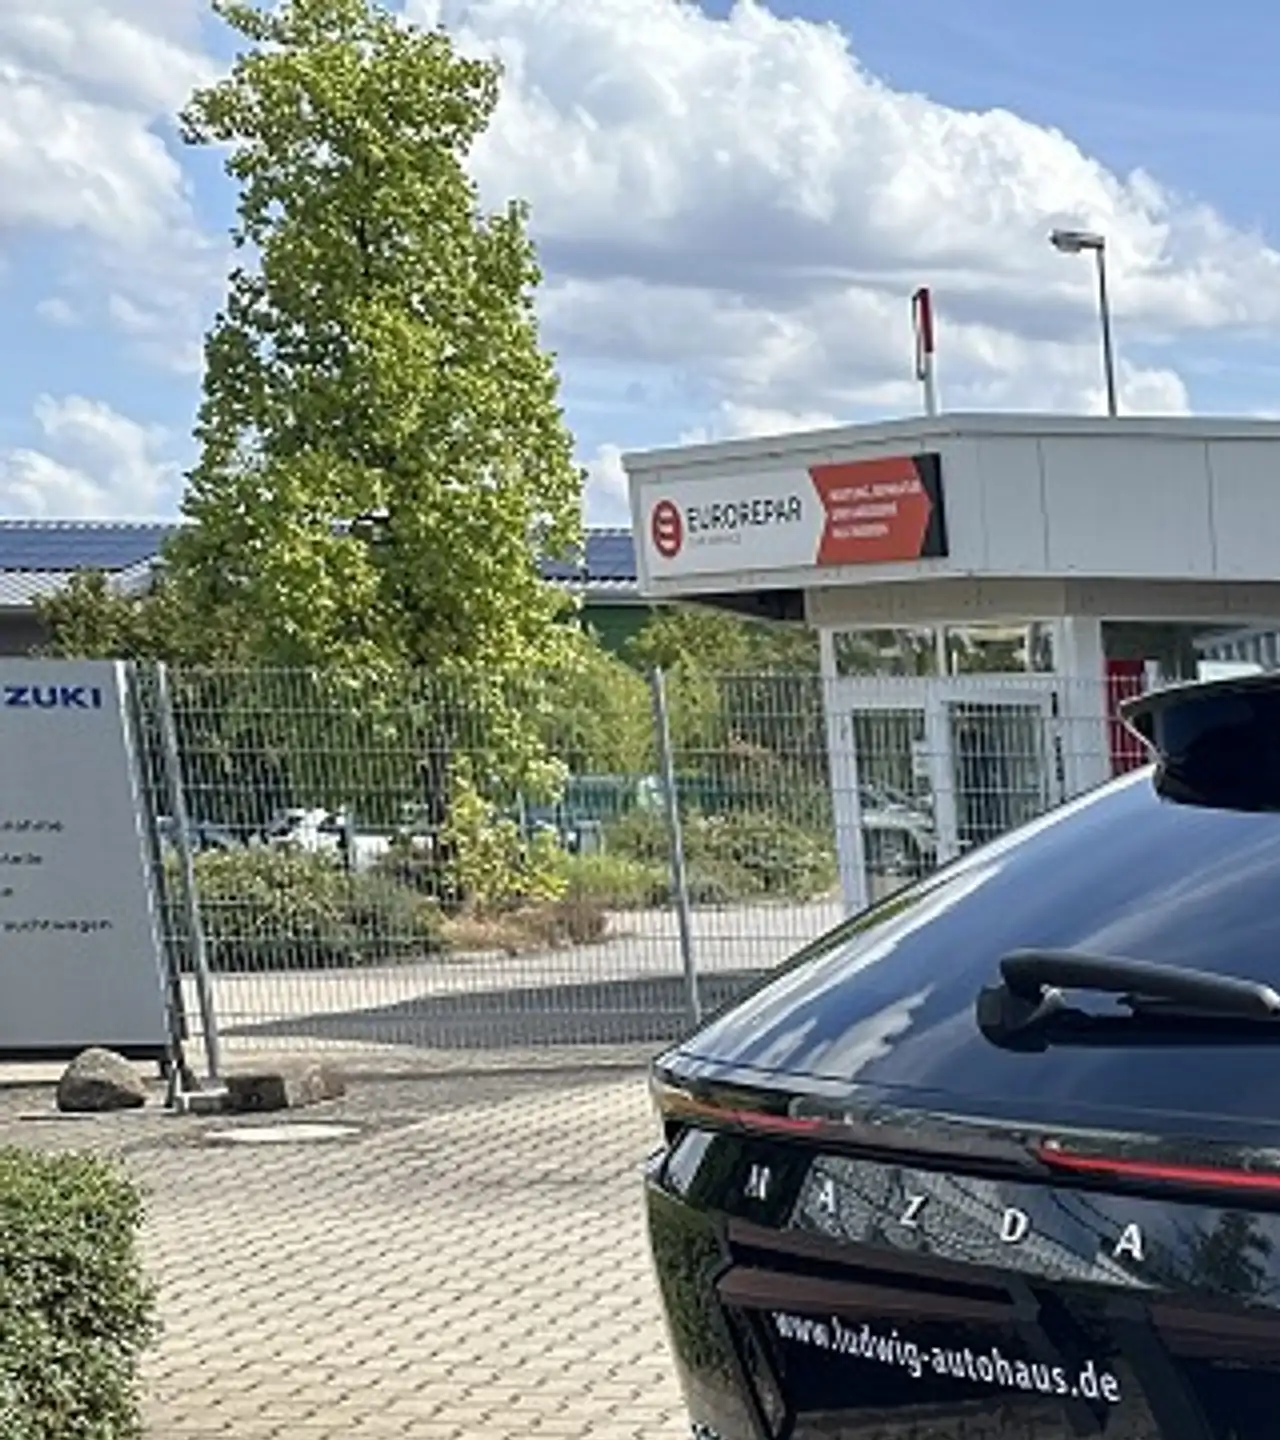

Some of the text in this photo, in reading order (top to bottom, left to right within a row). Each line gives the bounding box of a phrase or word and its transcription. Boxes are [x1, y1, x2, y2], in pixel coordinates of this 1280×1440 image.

[687, 495, 802, 533] EUROREPAR
[743, 1163, 1145, 1262] MAZDA
[772, 1312, 1121, 1403] www.ludwig-autohaus.de
